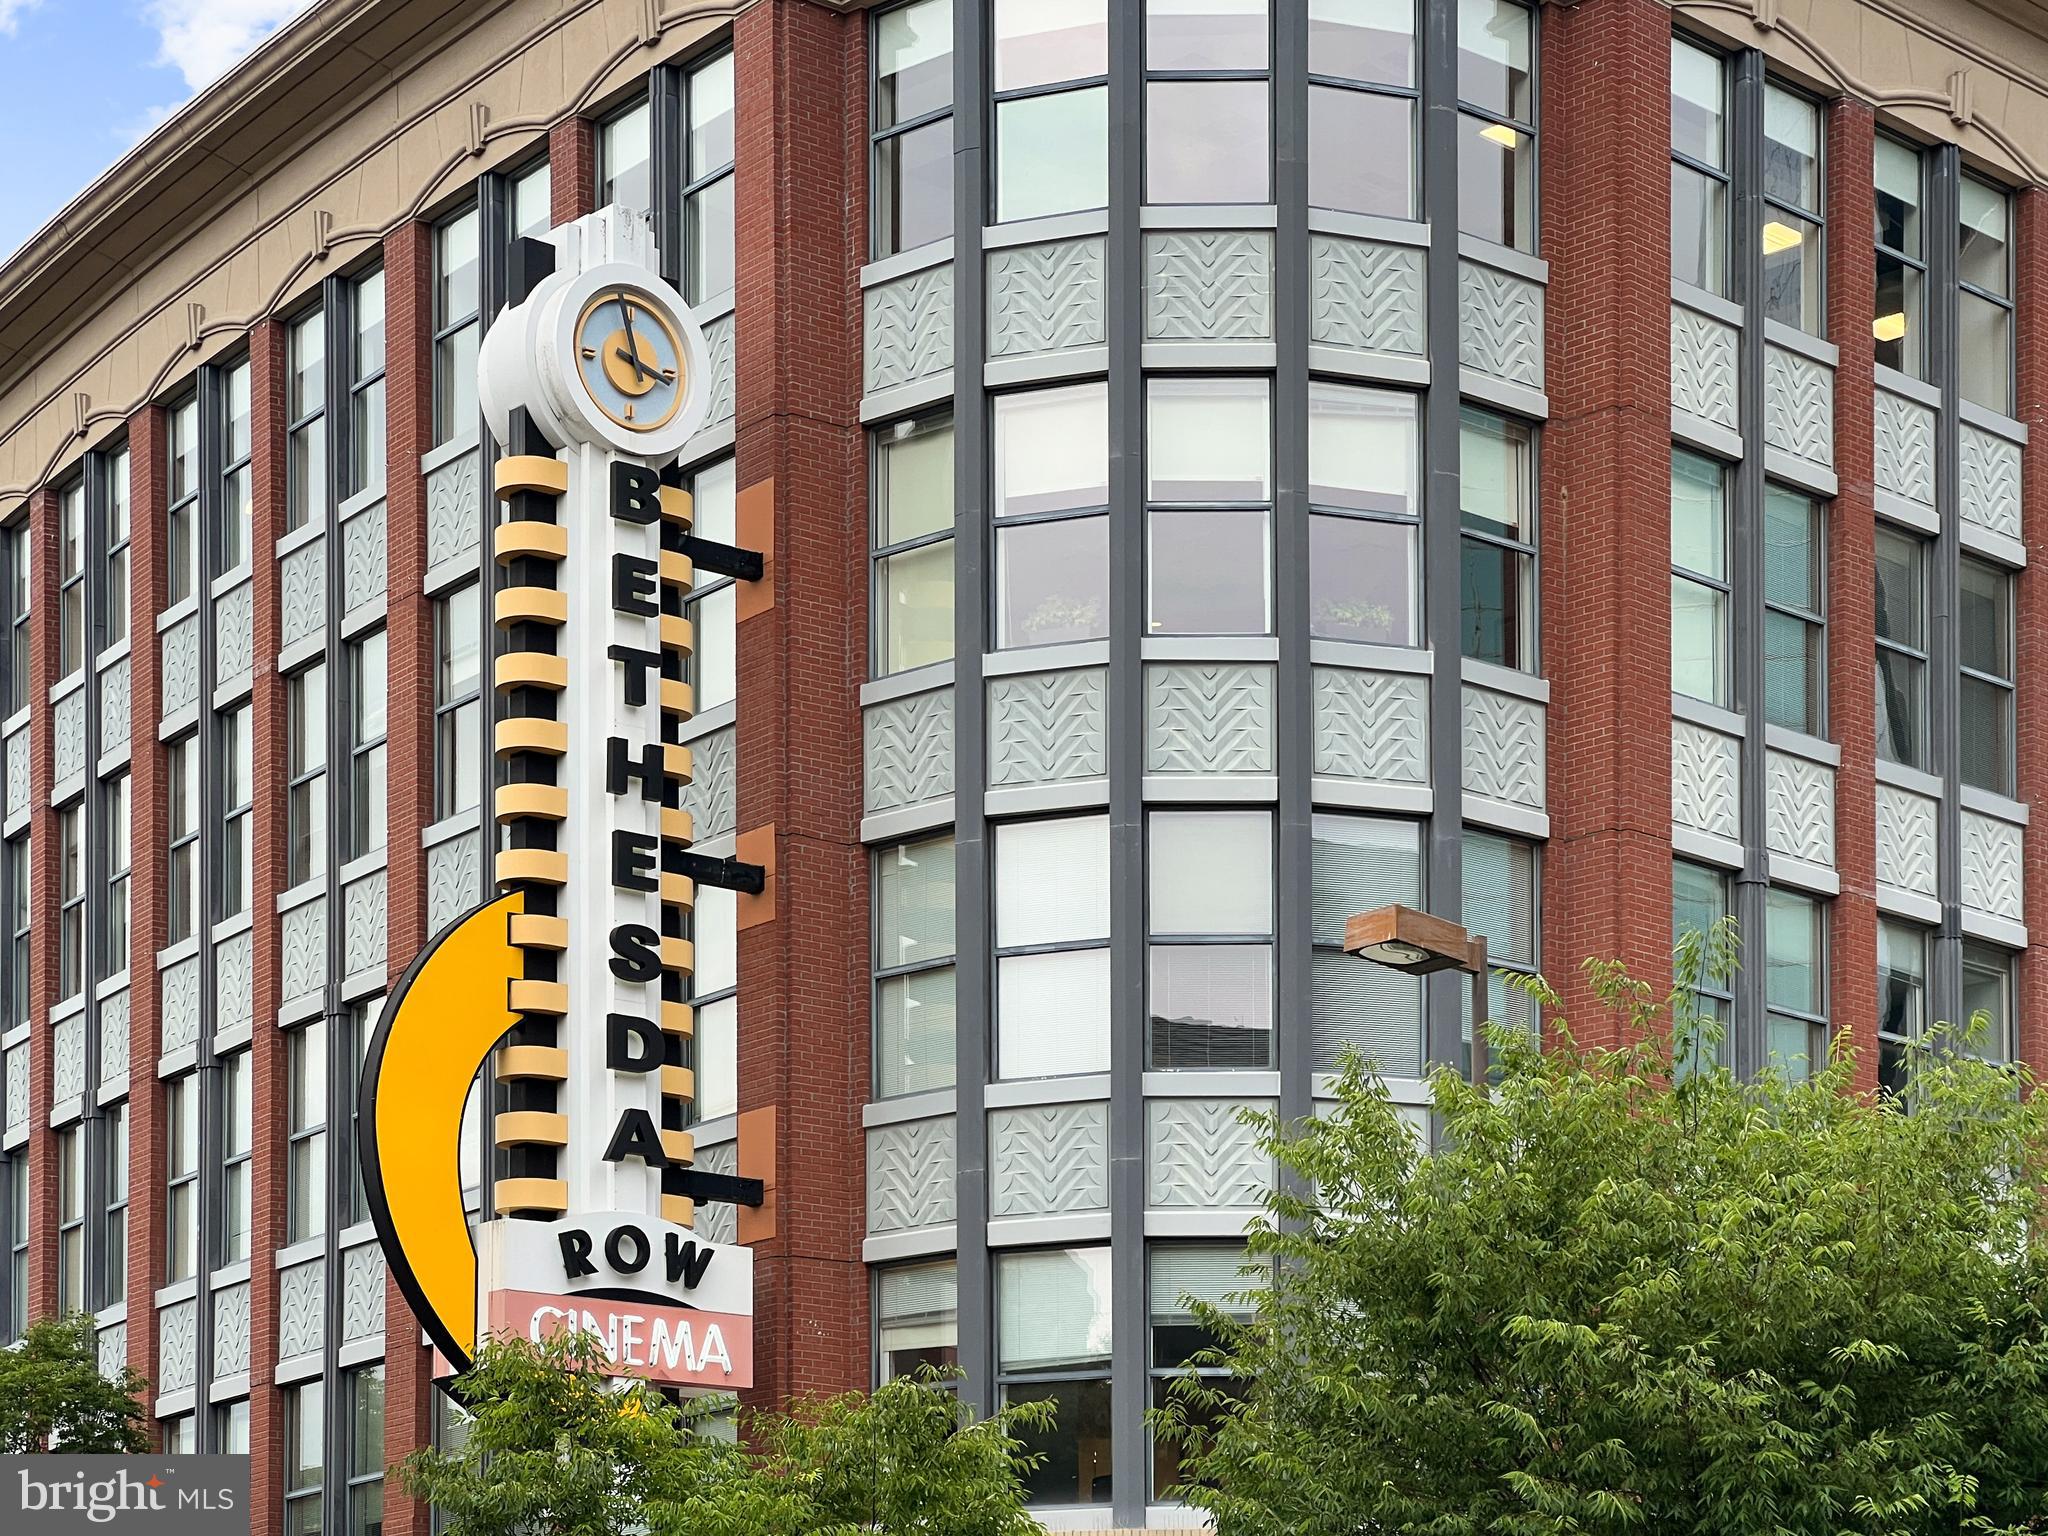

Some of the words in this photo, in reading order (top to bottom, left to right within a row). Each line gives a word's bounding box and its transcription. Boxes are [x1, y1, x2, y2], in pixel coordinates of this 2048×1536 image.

[602, 460, 669, 1169] BETHESDA
[558, 1224, 714, 1289] ROW
[529, 1305, 733, 1375] CINEMA
